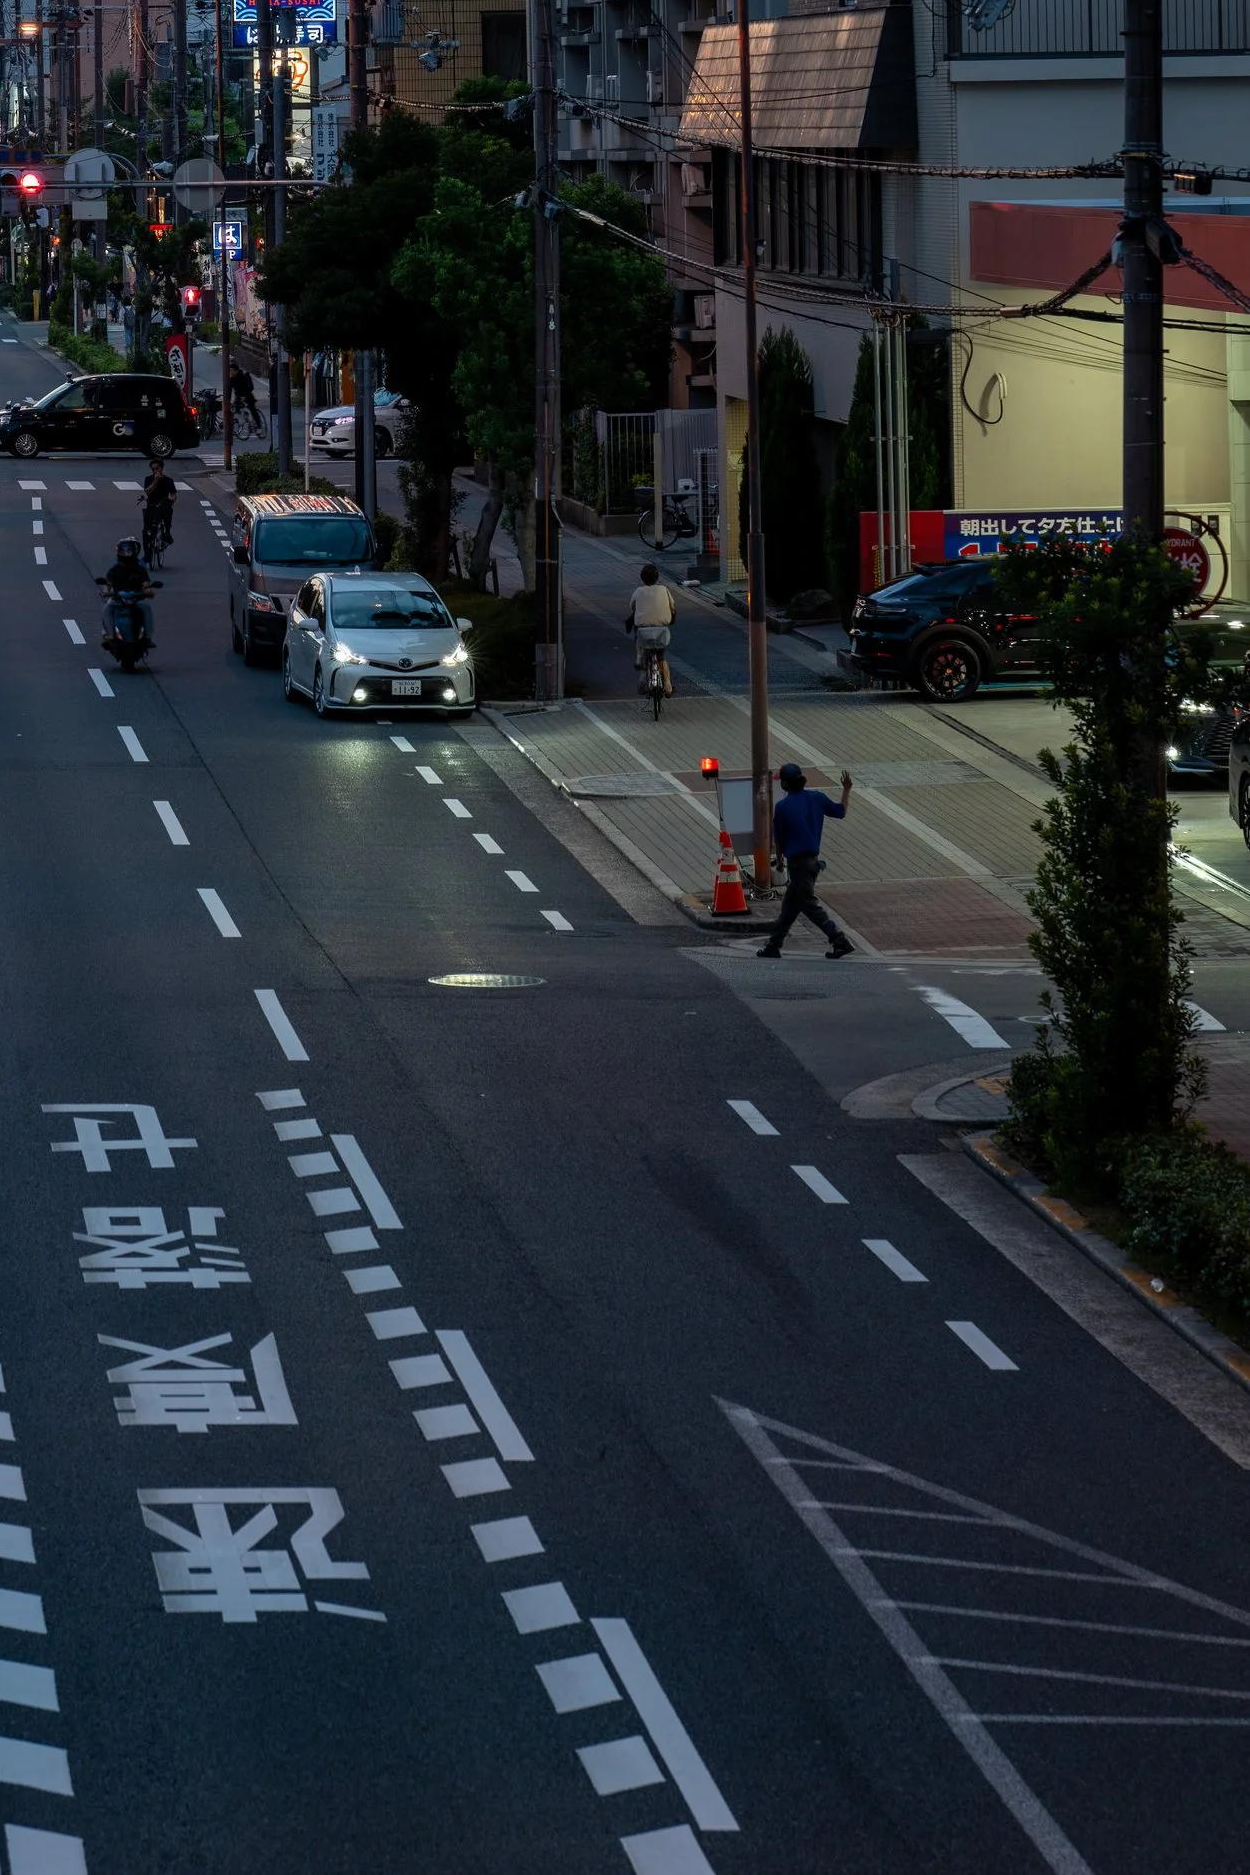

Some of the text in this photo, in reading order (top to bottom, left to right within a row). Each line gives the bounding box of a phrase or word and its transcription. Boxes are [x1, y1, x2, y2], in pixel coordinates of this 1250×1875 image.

[218, 225, 238, 244] は
[41, 1103, 387, 1623] 速度落せ
